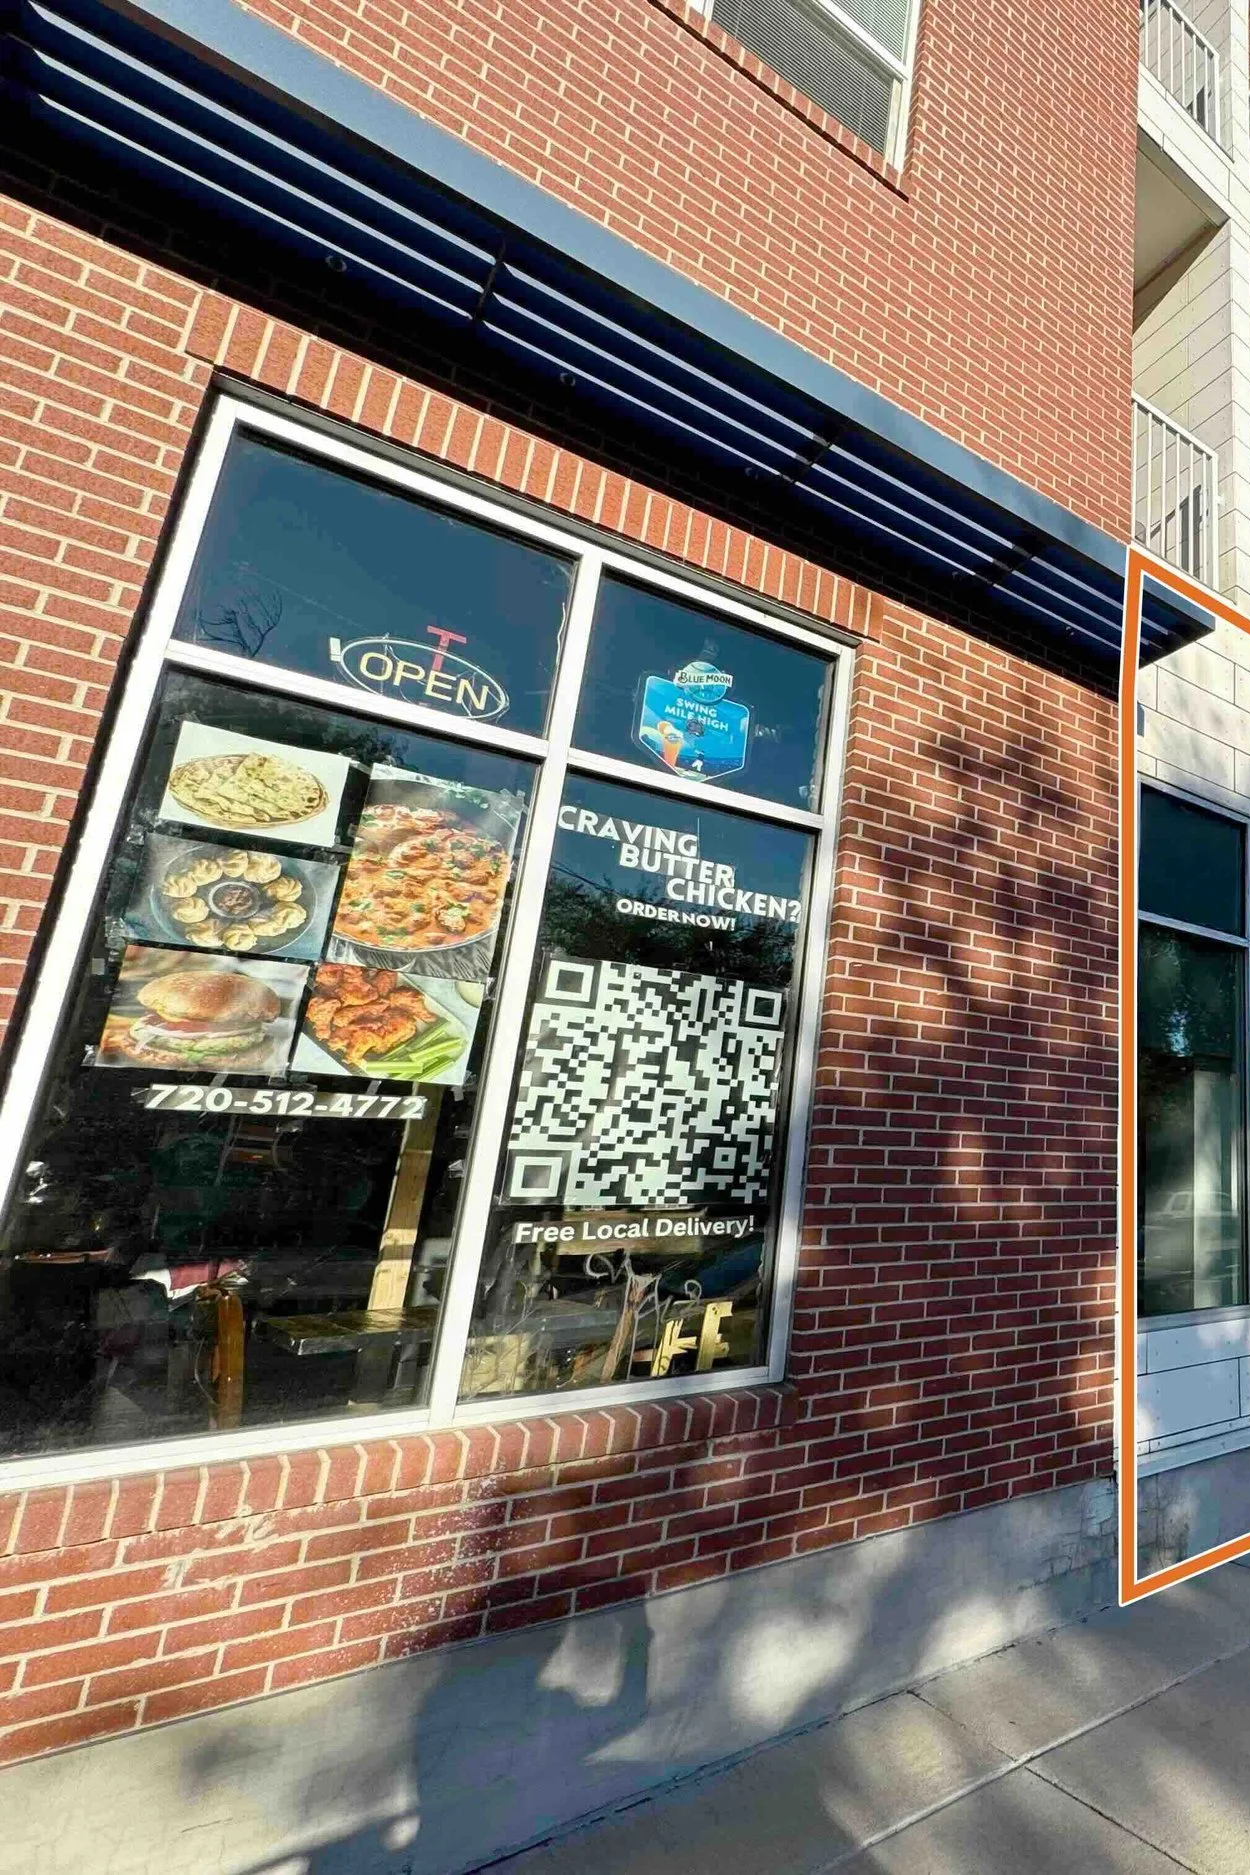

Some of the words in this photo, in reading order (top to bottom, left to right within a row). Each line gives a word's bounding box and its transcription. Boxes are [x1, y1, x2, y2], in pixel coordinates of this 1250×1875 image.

[360, 652, 488, 711] OPEN
[678, 672, 705, 684] BLUE
[706, 674, 731, 685] MOON
[664, 705, 695, 720] MILE
[698, 714, 729, 732] HIGH
[676, 697, 717, 717] SWING
[557, 805, 698, 857] CRAVING
[619, 843, 735, 888] BUTTER
[616, 899, 679, 923] ORDER
[682, 913, 735, 931] NOW!
[666, 878, 801, 923] CHICKEN?
[146, 1084, 426, 1119] 720-512-4772
[515, 1222, 575, 1243] Free
[583, 1218, 648, 1240] Local
[656, 1215, 754, 1238] Delivery!
